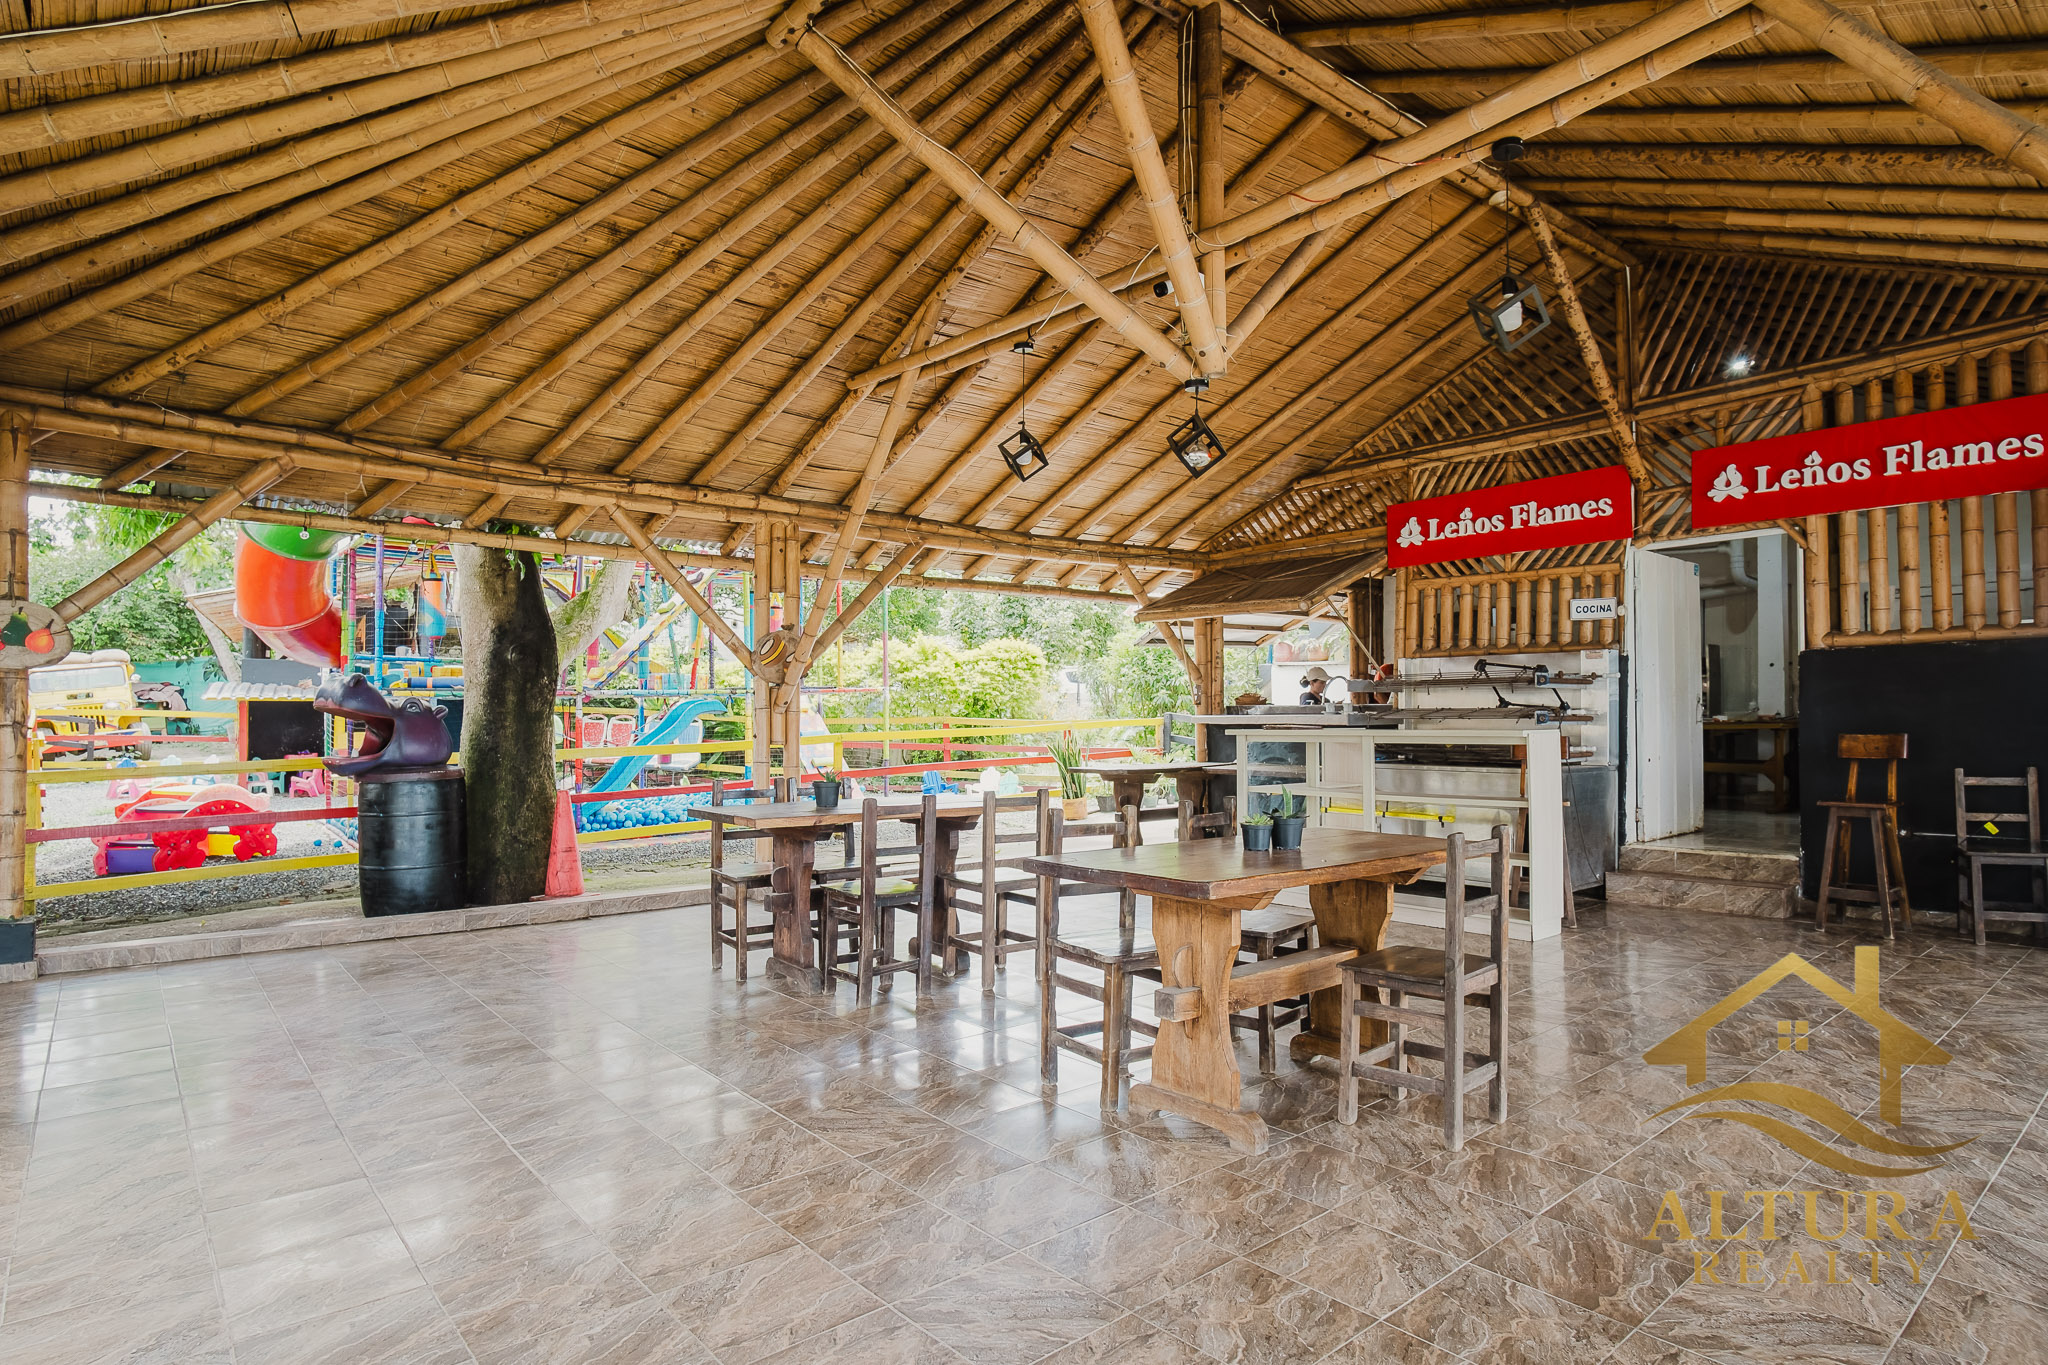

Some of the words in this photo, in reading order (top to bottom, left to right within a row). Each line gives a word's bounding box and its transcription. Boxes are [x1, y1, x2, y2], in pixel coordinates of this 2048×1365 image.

[1754, 450, 1872, 494] Leños
[1882, 433, 2045, 476] Flames
[1427, 507, 1505, 541] Leños
[1510, 497, 1614, 530] Flames
[1575, 604, 1612, 614] COCINA
